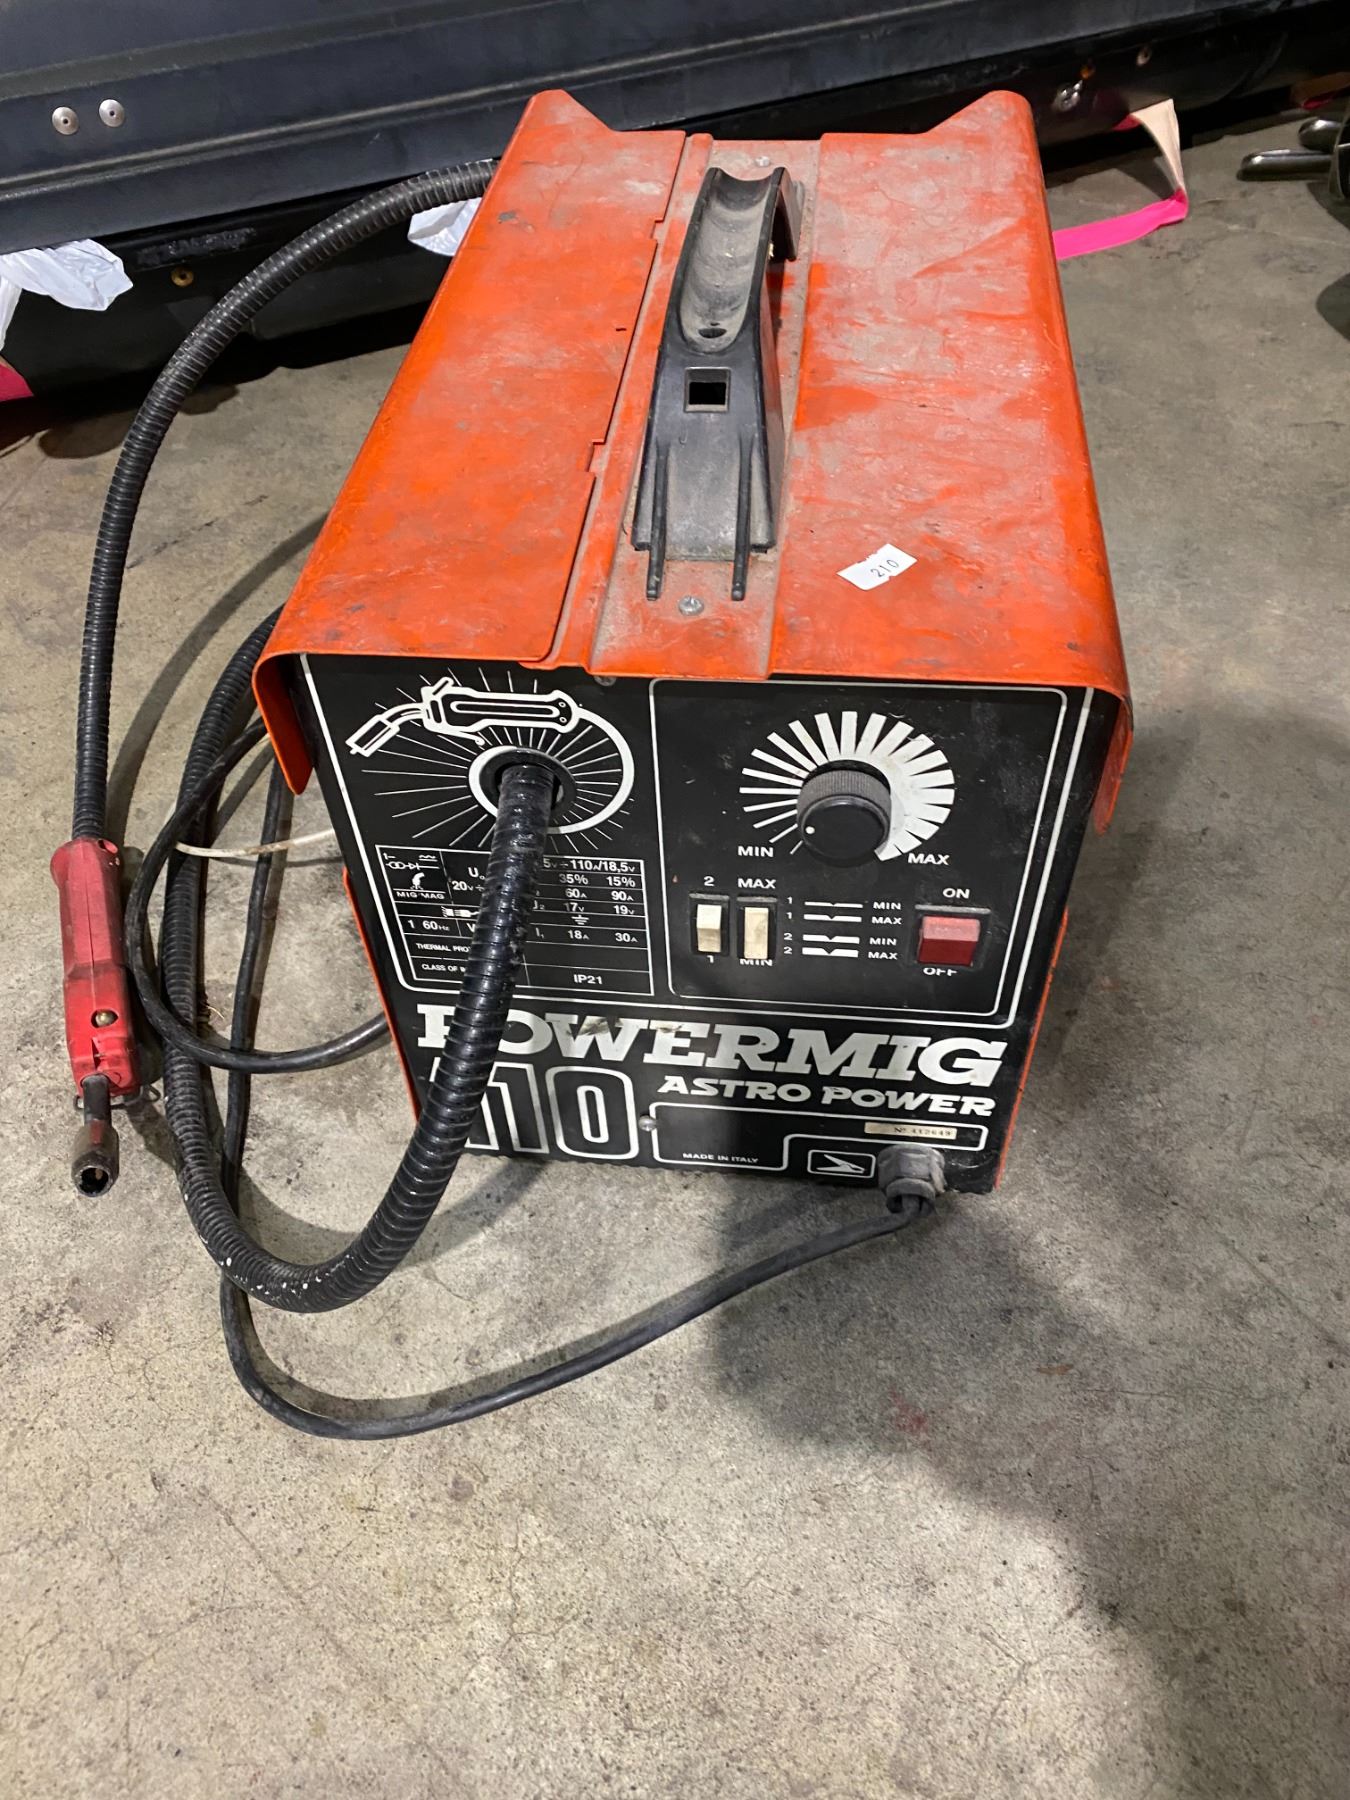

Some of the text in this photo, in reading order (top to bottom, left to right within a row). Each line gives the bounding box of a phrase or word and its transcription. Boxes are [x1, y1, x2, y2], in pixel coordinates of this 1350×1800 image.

[870, 560, 900, 578] 210
[737, 845, 774, 858] MIN
[907, 853, 950, 866] MAX
[559, 873, 636, 888] 35% 15%
[703, 876, 715, 887] 2
[737, 878, 777, 889] MAX
[942, 888, 970, 899] ON
[786, 896, 902, 910] 1 MIN
[786, 912, 902, 925] 1 MAX
[783, 932, 897, 946] 2 MIN
[415, 942, 471, 953] THERMAL PRO
[783, 946, 898, 960] 2 MAX
[421, 963, 447, 972] CLASS
[739, 958, 773, 967] MIN
[573, 973, 603, 985] IP21
[657, 1075, 996, 1117] ASTRO POWER
[682, 1152, 714, 1160] MADE
[731, 1156, 758, 1164] ITALY
